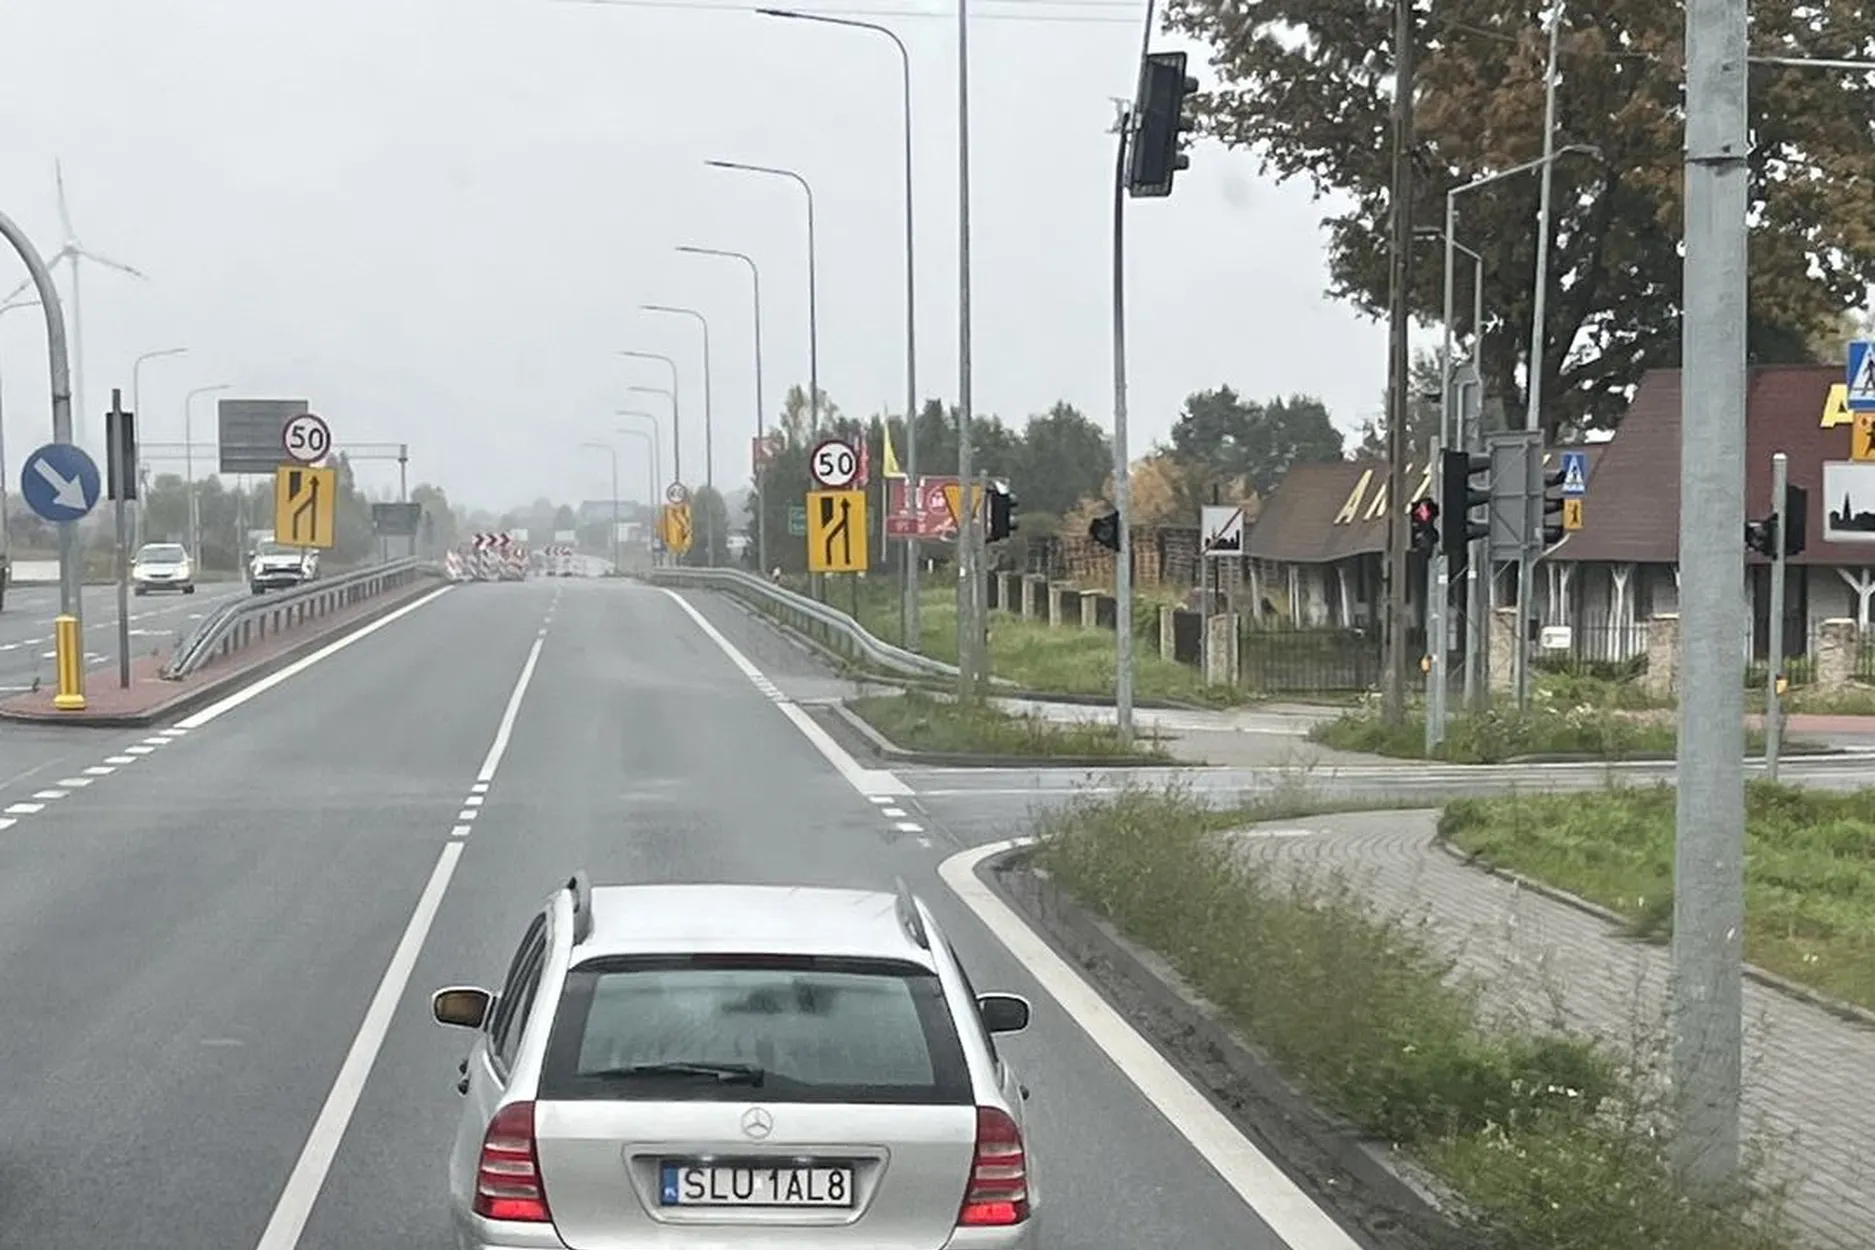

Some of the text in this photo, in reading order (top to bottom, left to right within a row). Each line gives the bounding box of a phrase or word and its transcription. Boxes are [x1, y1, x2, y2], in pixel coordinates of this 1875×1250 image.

[290, 425, 323, 451] 50
[819, 452, 853, 476] 50
[684, 1168, 845, 1201] SLU 1AL8
